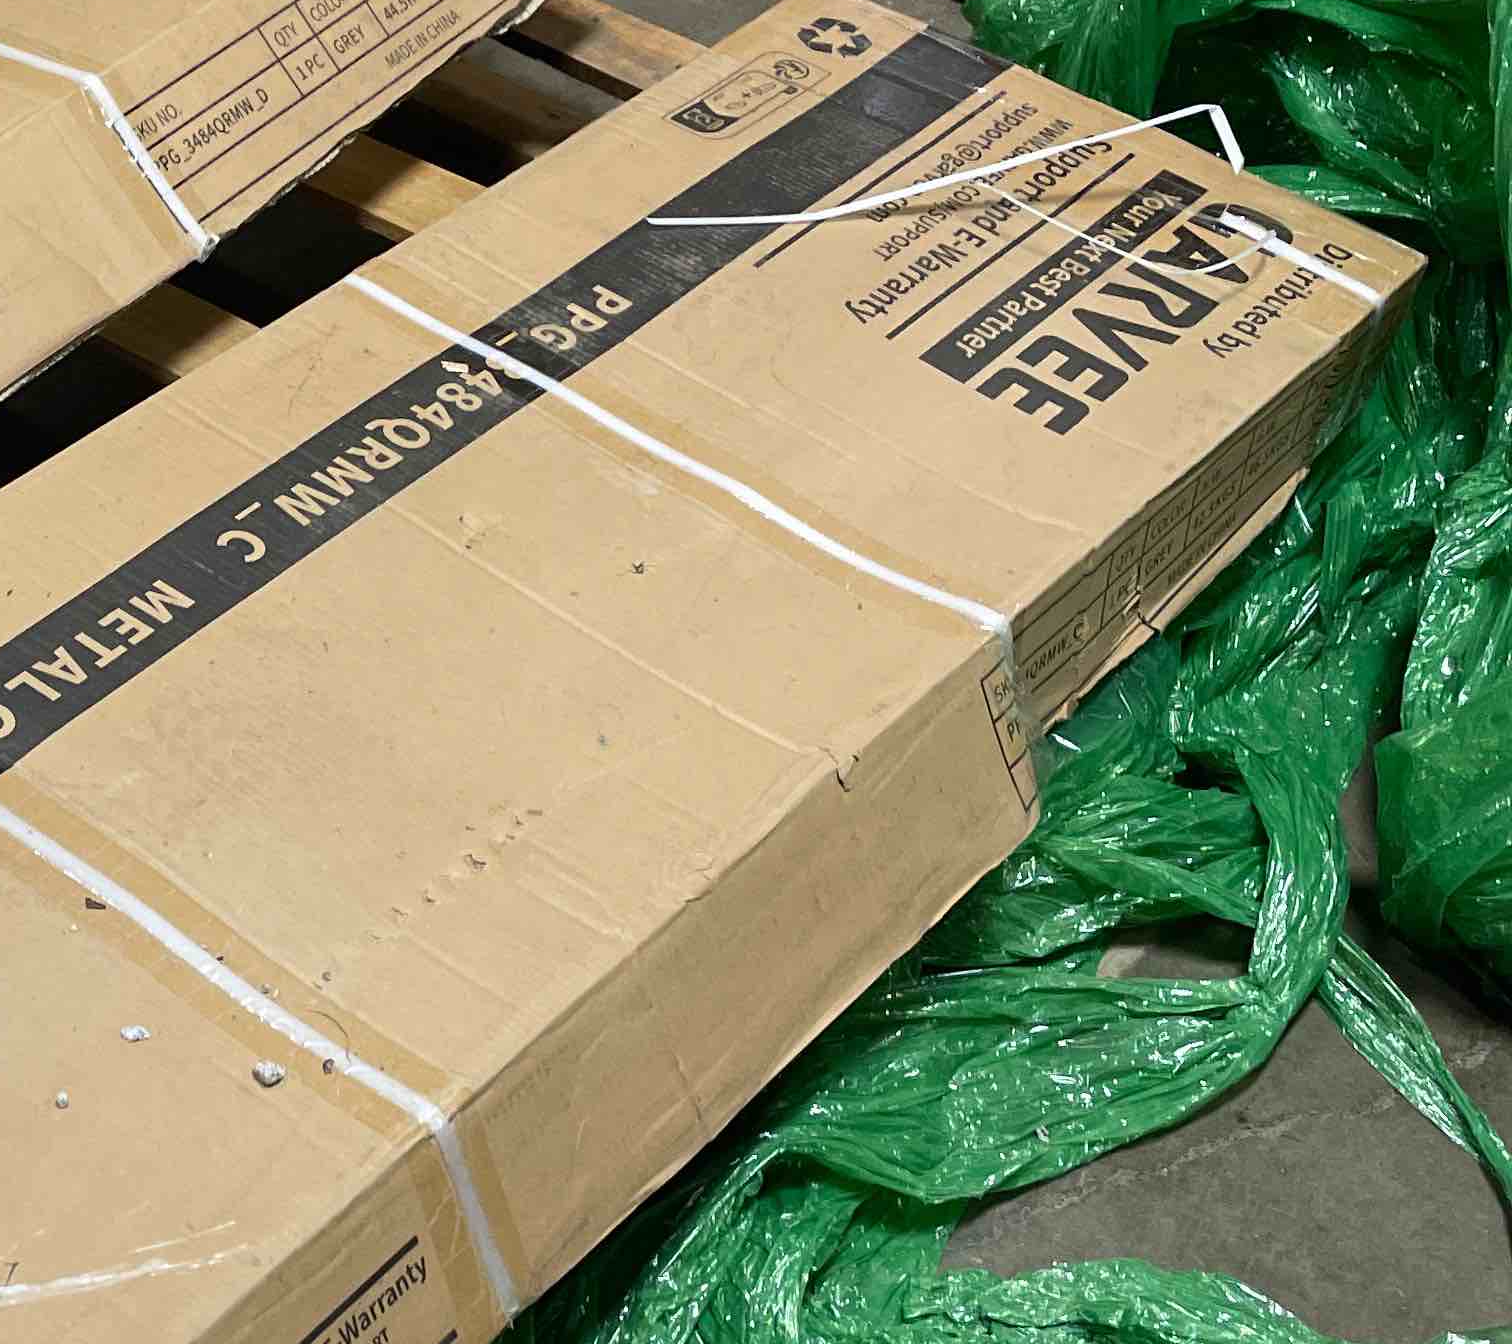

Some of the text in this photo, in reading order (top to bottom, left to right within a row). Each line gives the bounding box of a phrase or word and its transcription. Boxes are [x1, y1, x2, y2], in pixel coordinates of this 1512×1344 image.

[273, 20, 297, 47] QTY
[333, 22, 366, 56] GREY
[844, 133, 1113, 324] Support and E-Warranty
[955, 189, 1183, 359] Your Next Best Partner
[976, 202, 1294, 436] GARVEE
[1202, 242, 1354, 359] Ditributed by
[4, 579, 196, 702] METAL
